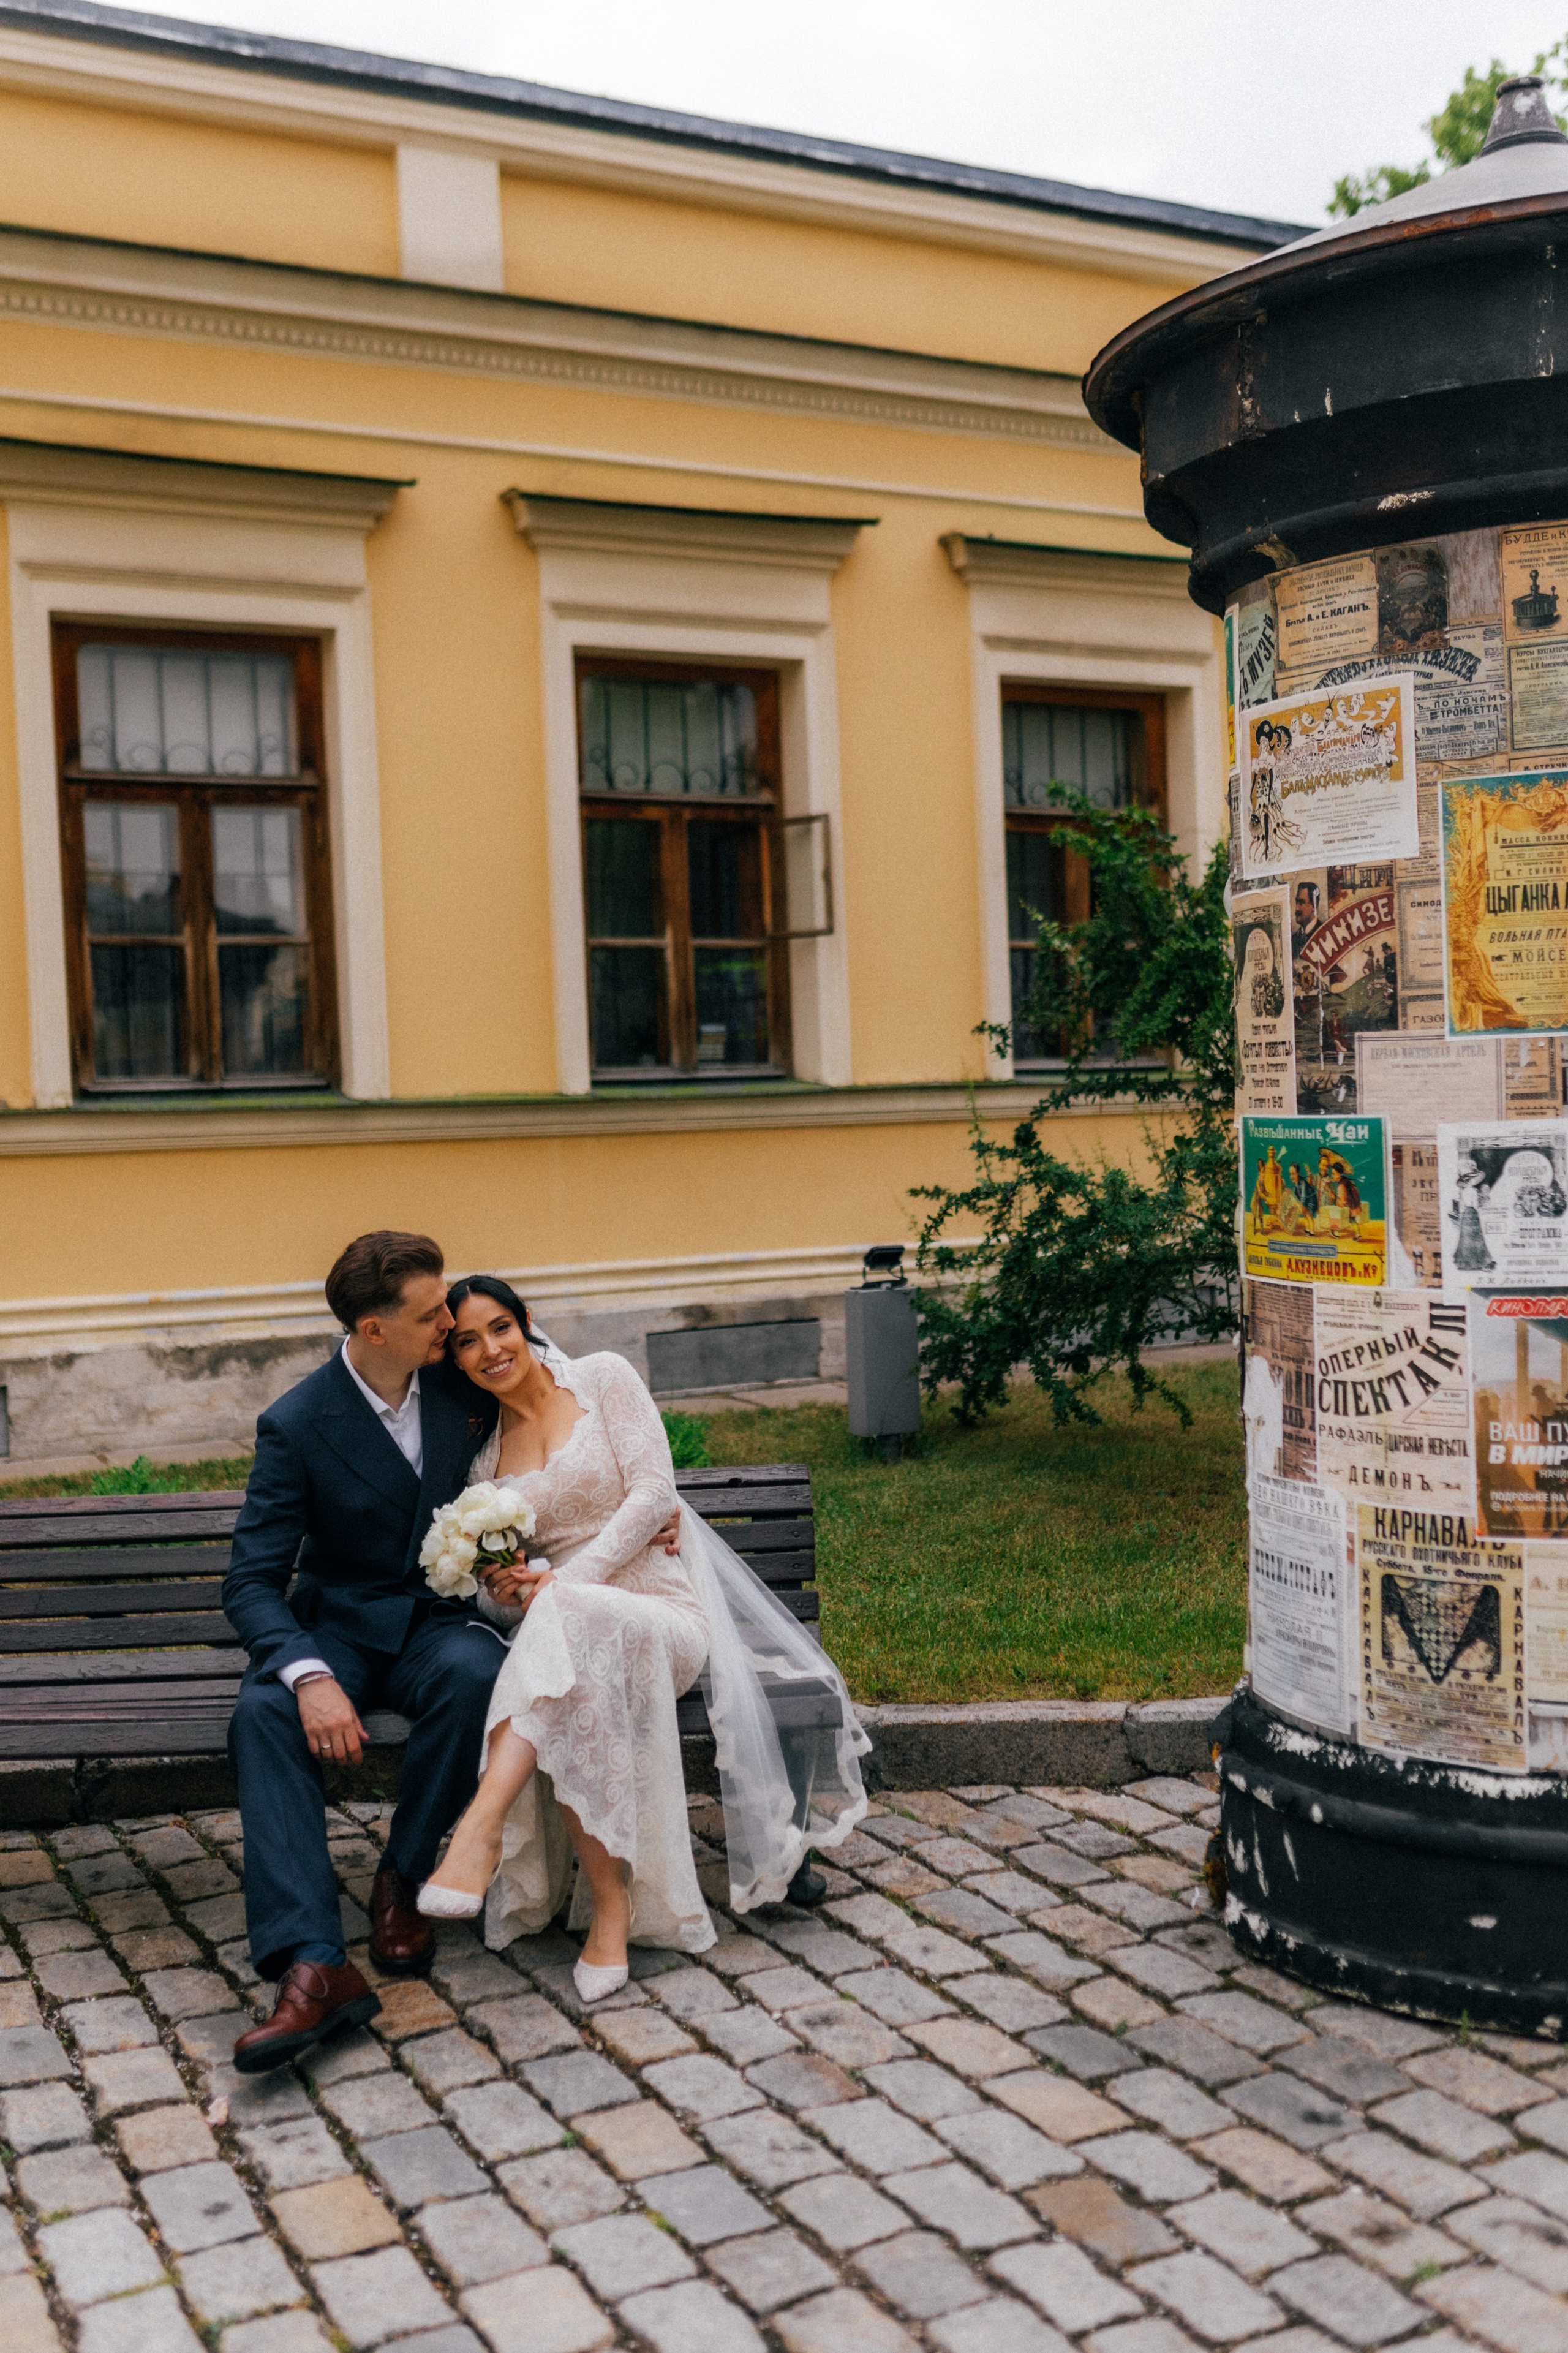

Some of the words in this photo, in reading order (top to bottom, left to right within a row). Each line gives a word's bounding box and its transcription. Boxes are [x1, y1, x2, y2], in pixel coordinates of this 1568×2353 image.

[1505, 531, 1549, 545] БУДДЕ
[1307, 613, 1314, 622] А.
[1321, 610, 1329, 619] Е.
[1330, 603, 1371, 617] КАГАНЪ.
[1312, 624, 1338, 633] СКЛАДЪ
[1454, 693, 1506, 705] НОЧАМЪ
[1487, 882, 1561, 916] ЦЫГАНКА
[1489, 929, 1542, 943] ВОЛЬНАЯ
[1319, 1325, 1420, 1378] ОПЕРНЫЙ
[1319, 1424, 1384, 1445] РАФАЭЛЬ
[1389, 1433, 1424, 1454] ЦАРСКАЯ
[1489, 1421, 1540, 1443] ВАШ
[1488, 1444, 1506, 1464] В
[1490, 1491, 1550, 1503] ПОДРОБНЕЕ
[1550, 1492, 1566, 1503] НА
[1374, 1507, 1506, 1551] КАРНАВА
[1362, 1539, 1406, 1558] РУССКАГО
[1488, 1554, 1523, 1570] КЛУБА
